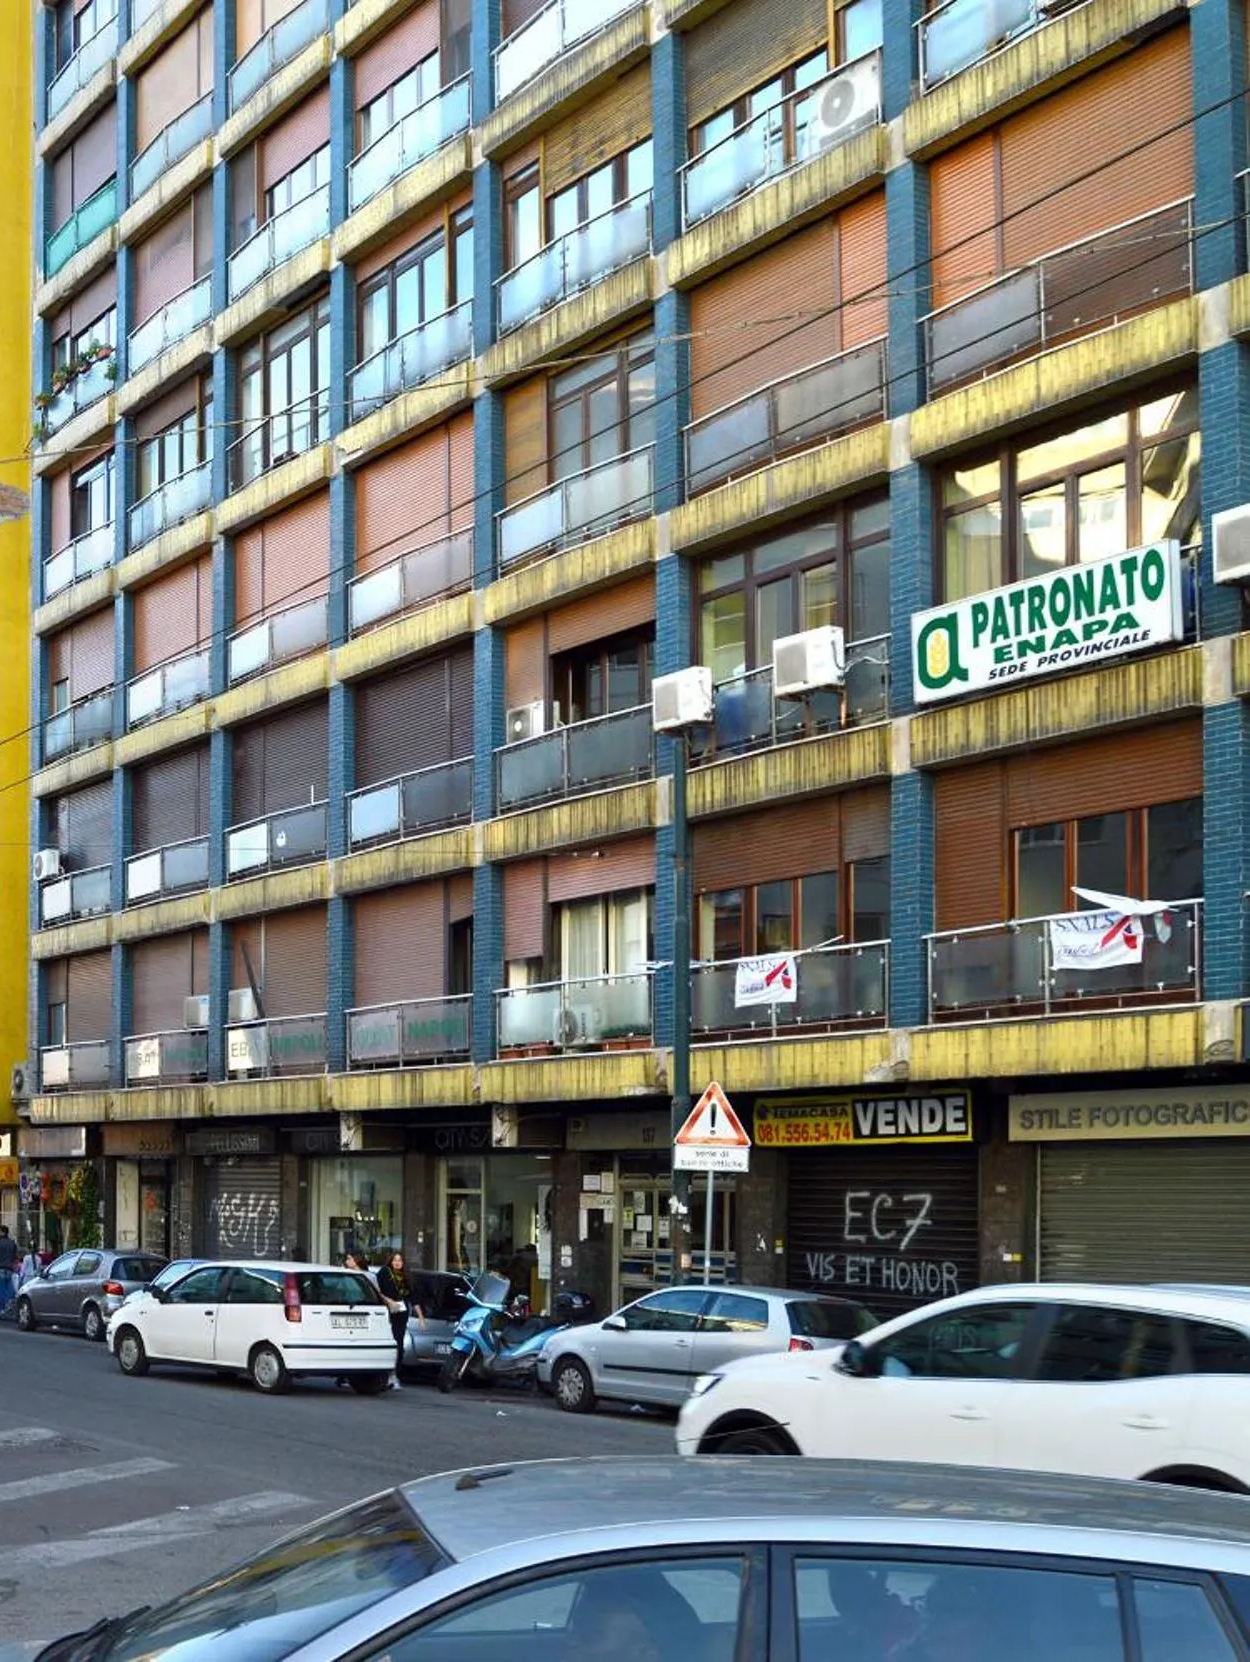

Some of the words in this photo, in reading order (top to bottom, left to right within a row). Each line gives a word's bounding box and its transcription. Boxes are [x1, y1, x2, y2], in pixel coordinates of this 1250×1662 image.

[971, 548, 1165, 649] PATRONATO
[988, 661, 1028, 681] SEDE
[1037, 629, 1152, 669] PROVINCIALE
[993, 611, 1141, 665] ENAPA
[757, 1120, 851, 1144] 081.556.54.74
[854, 1096, 967, 1136] VENDE
[1019, 1107, 1082, 1130] STILE
[844, 1191, 933, 1251] EC7
[806, 1252, 835, 1281] VIS
[846, 1253, 875, 1286] ET
[881, 1257, 959, 1297] HONOR
